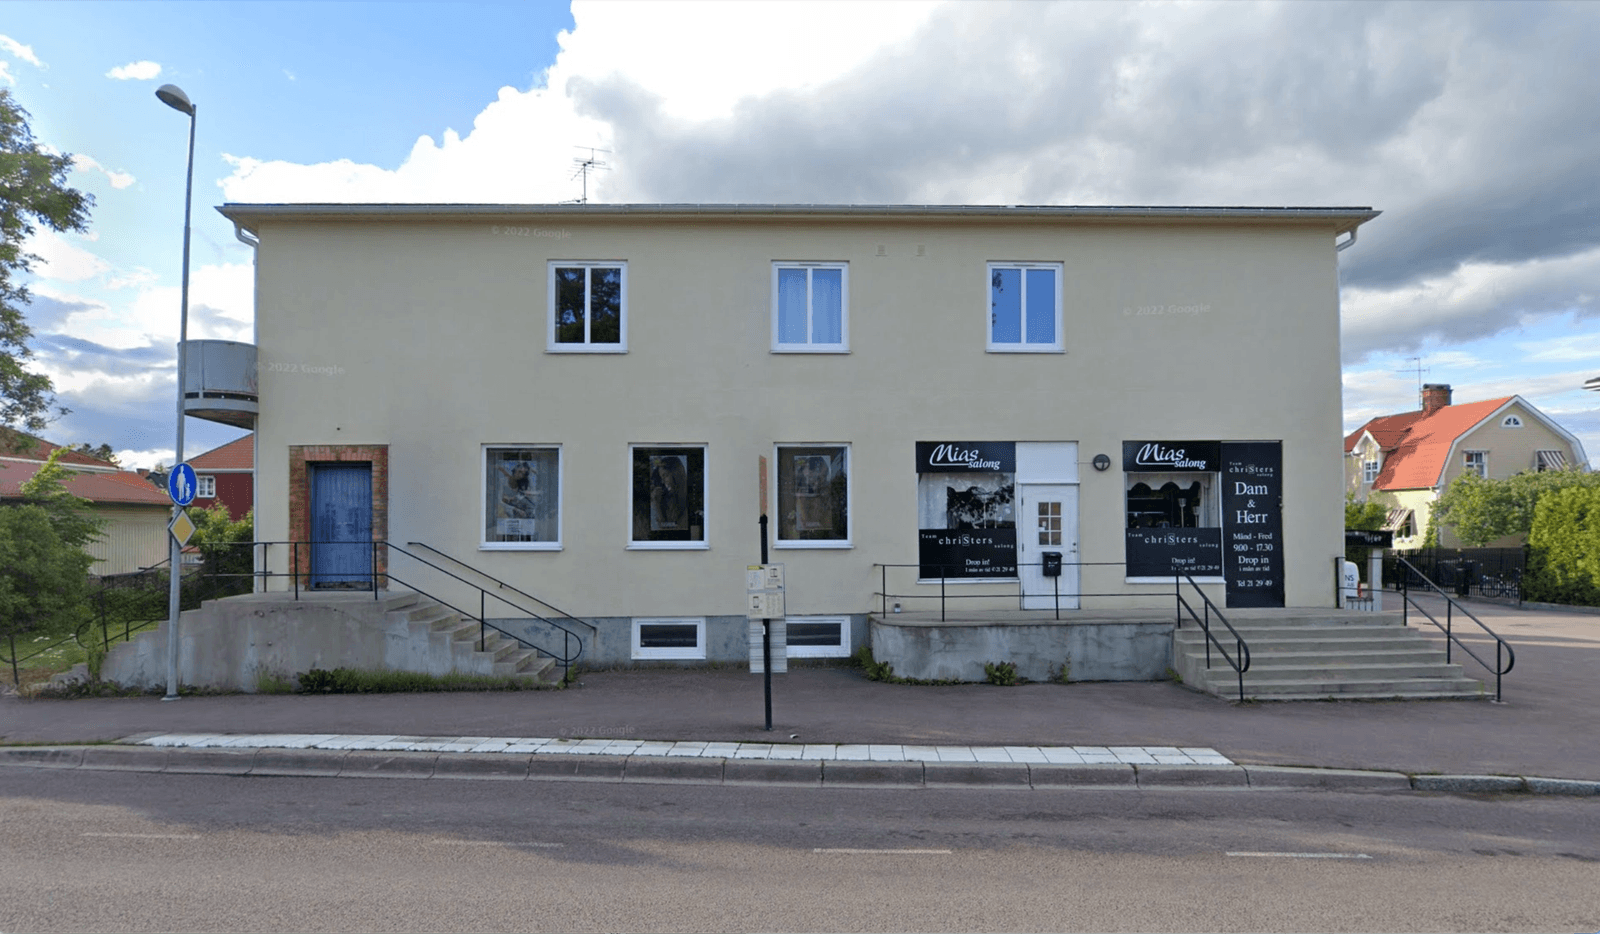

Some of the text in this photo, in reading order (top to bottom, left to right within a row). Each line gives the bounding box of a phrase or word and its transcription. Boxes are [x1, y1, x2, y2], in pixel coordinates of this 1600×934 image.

[929, 443, 1001, 471] Mias salong
[1135, 443, 1207, 470] Mias salong
[1234, 481, 1268, 495] Dam
[1247, 499, 1256, 508] &
[1236, 510, 1268, 524] Herr
[1258, 532, 1273, 540] Fred
[1238, 555, 1269, 566] Drop in
